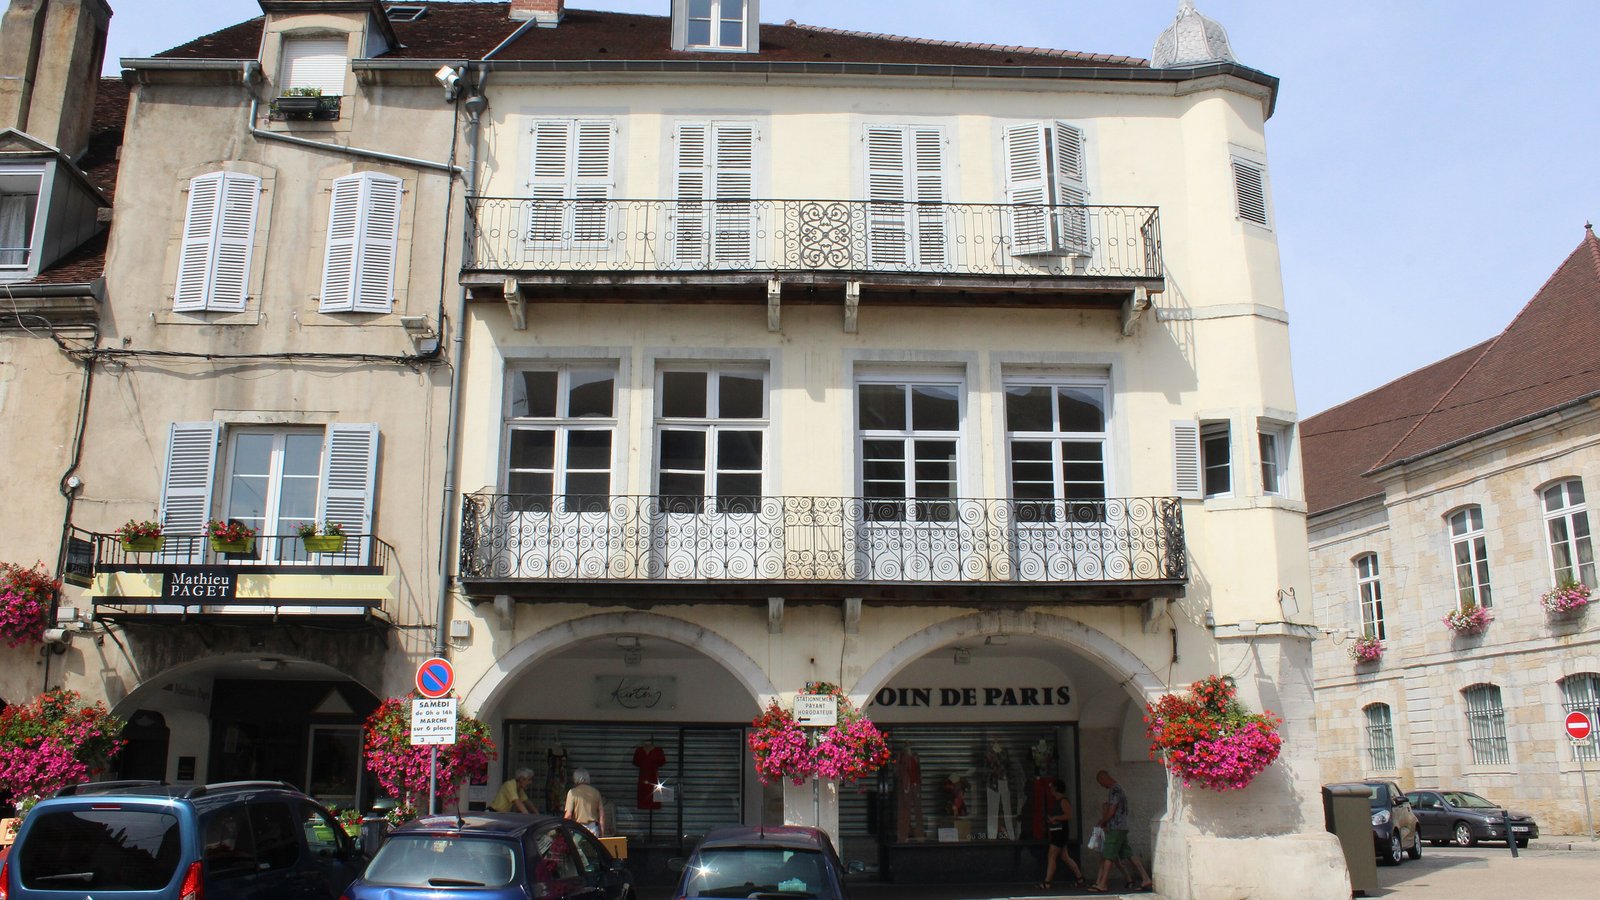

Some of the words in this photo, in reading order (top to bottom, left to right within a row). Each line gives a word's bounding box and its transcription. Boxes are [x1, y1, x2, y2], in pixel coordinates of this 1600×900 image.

[171, 572, 230, 585] Mathieu
[170, 585, 230, 597] PAGET
[868, 687, 932, 708] OIN
[939, 687, 976, 707] DE
[983, 686, 1071, 706] PARIS
